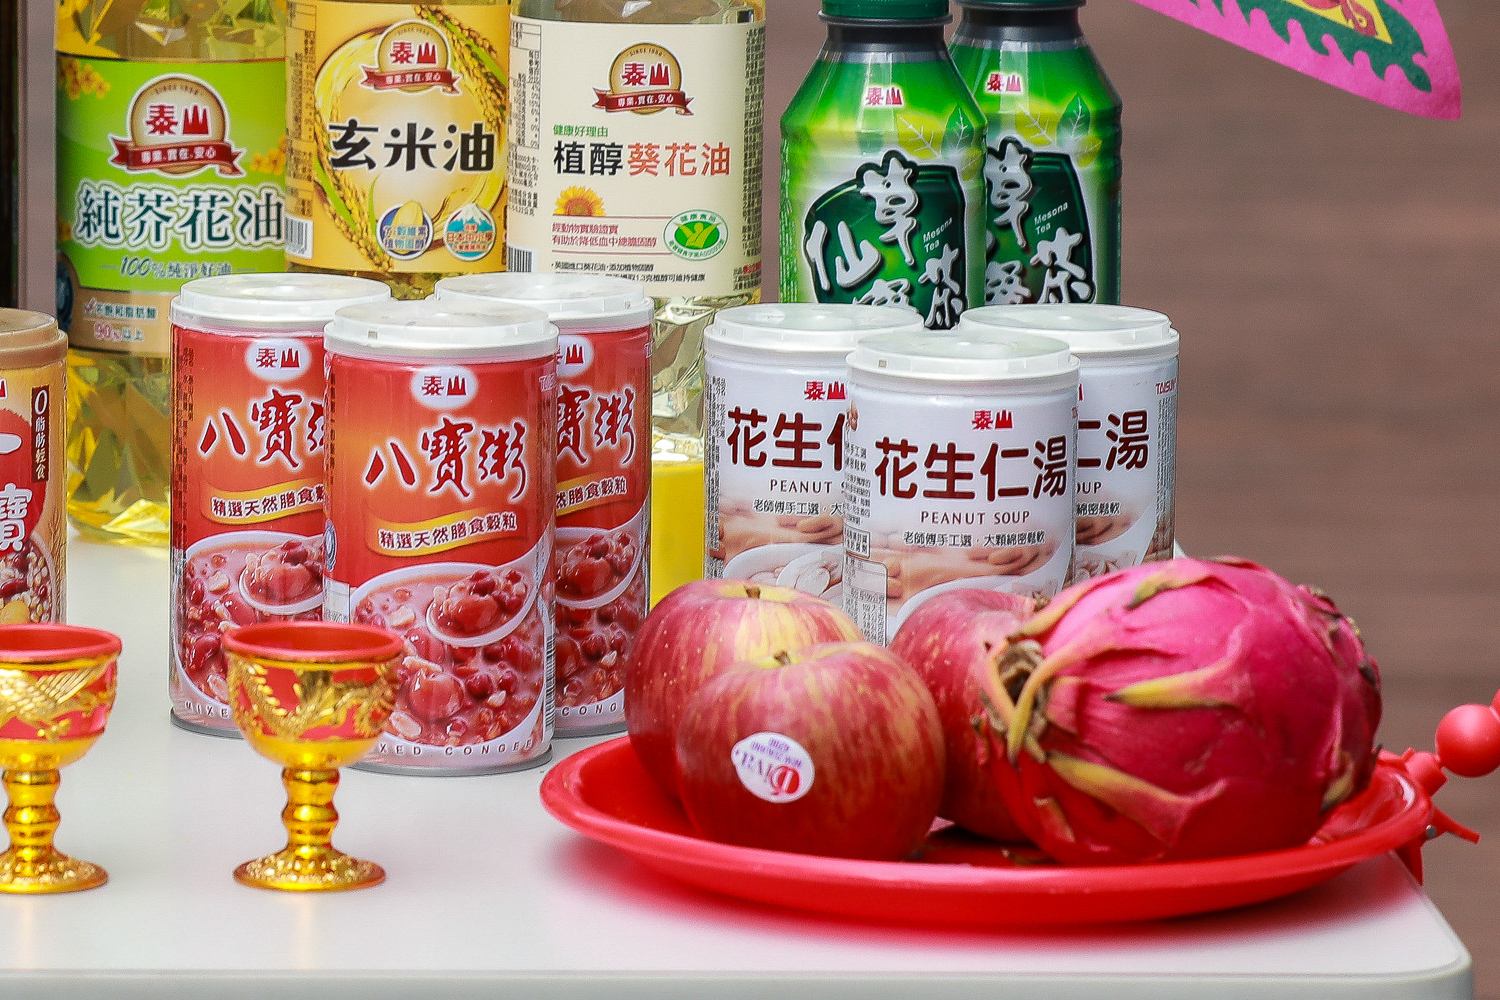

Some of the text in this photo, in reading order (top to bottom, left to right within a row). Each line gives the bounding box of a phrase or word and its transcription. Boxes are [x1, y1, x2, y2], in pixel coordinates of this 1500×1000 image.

[390, 41, 437, 64] 泰山
[621, 62, 670, 86] 泰山
[987, 73, 1022, 91] 泰山
[866, 87, 903, 105] 泰山
[146, 104, 210, 135] 泰山
[328, 119, 495, 172] 玄米油
[79, 188, 283, 243] 純芥花油
[1034, 200, 1068, 225] Mesona
[1035, 223, 1052, 236] Tea
[924, 240, 941, 253] Tea
[257, 348, 300, 368] 泰山
[422, 375, 466, 396] 泰山
[804, 381, 846, 400] 泰山
[972, 410, 1013, 429] 泰山
[366, 417, 526, 499] 八寶粥
[875, 435, 1067, 502] 花生仁湯
[770, 479, 833, 494] PEANUT
[921, 511, 1030, 525] PEANUT SOUP
[379, 512, 518, 548] 精選天然膳食穀粒
[445, 739, 534, 756] CONGEE
